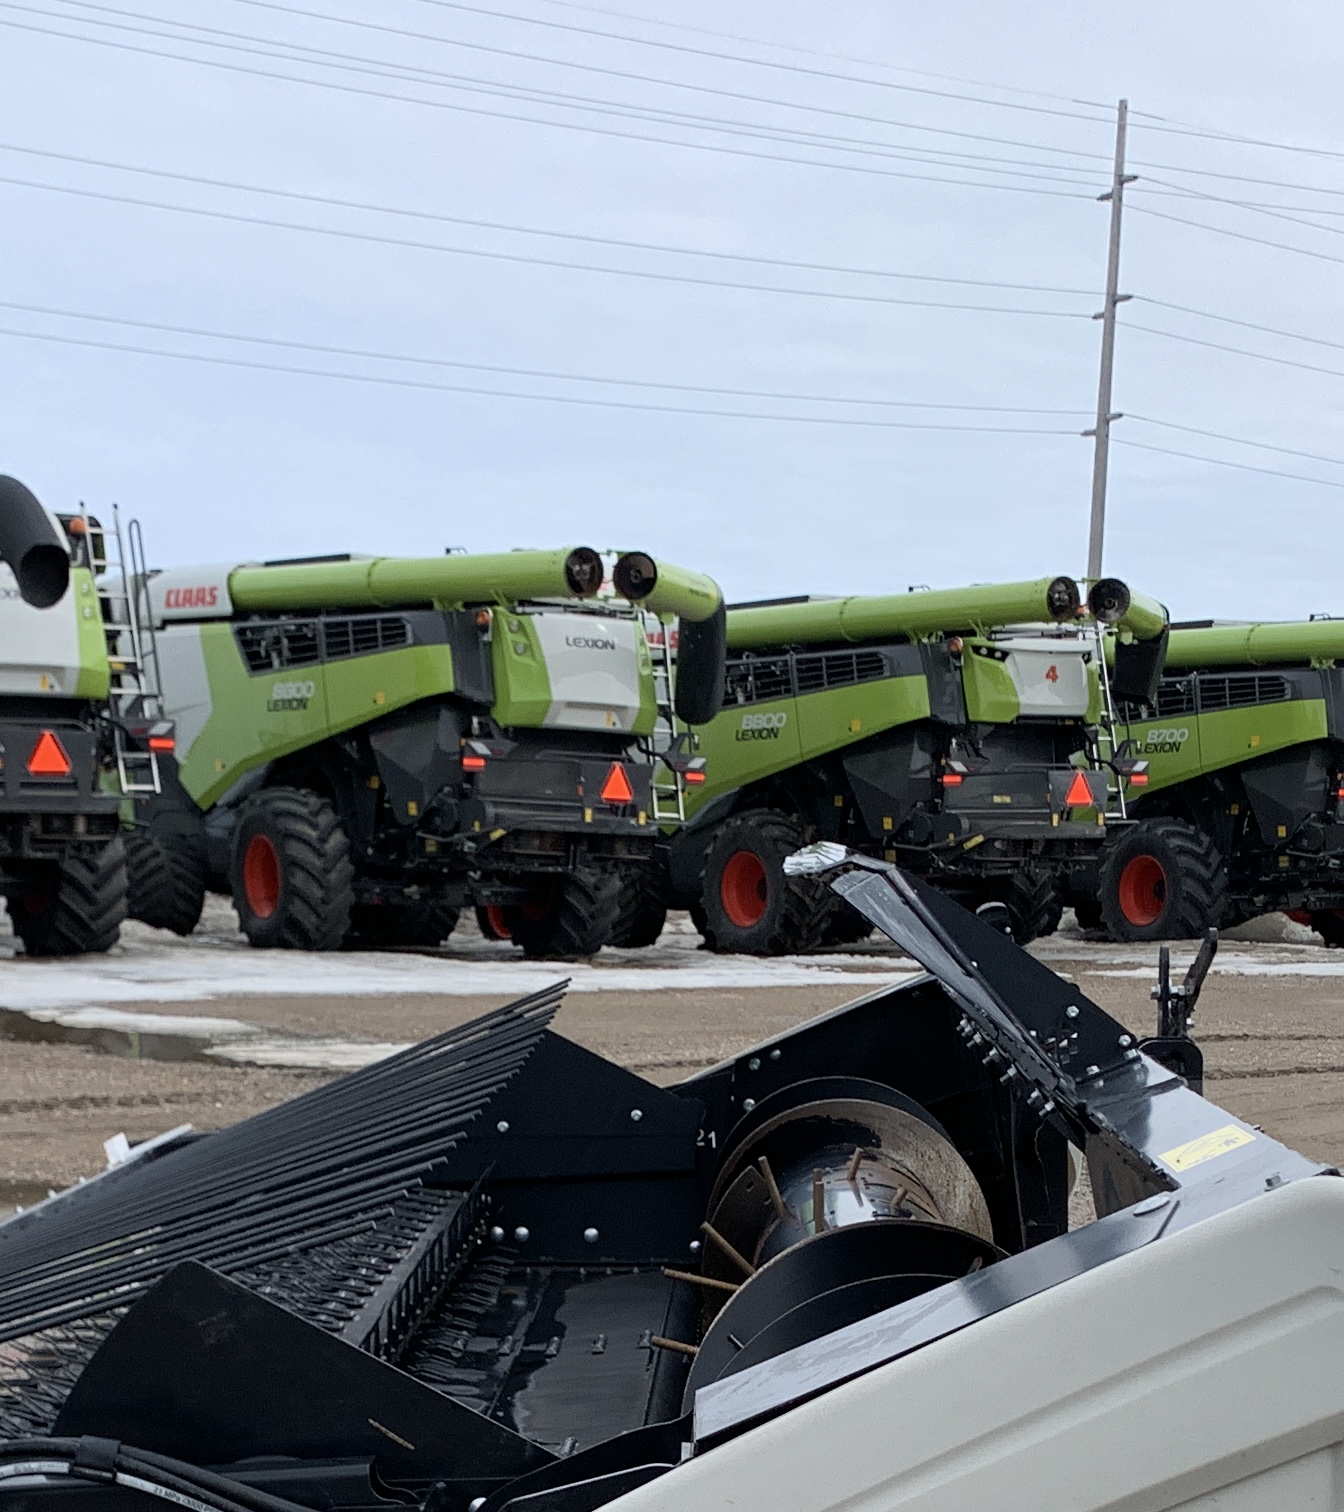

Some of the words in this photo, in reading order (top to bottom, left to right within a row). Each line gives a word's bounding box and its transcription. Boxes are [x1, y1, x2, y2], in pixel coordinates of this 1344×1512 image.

[164, 586, 218, 609] CLAAS
[565, 635, 616, 650] LEXION
[1045, 665, 1059, 683] 4
[735, 728, 780, 742] LEXION
[1147, 728, 1189, 743] 8700
